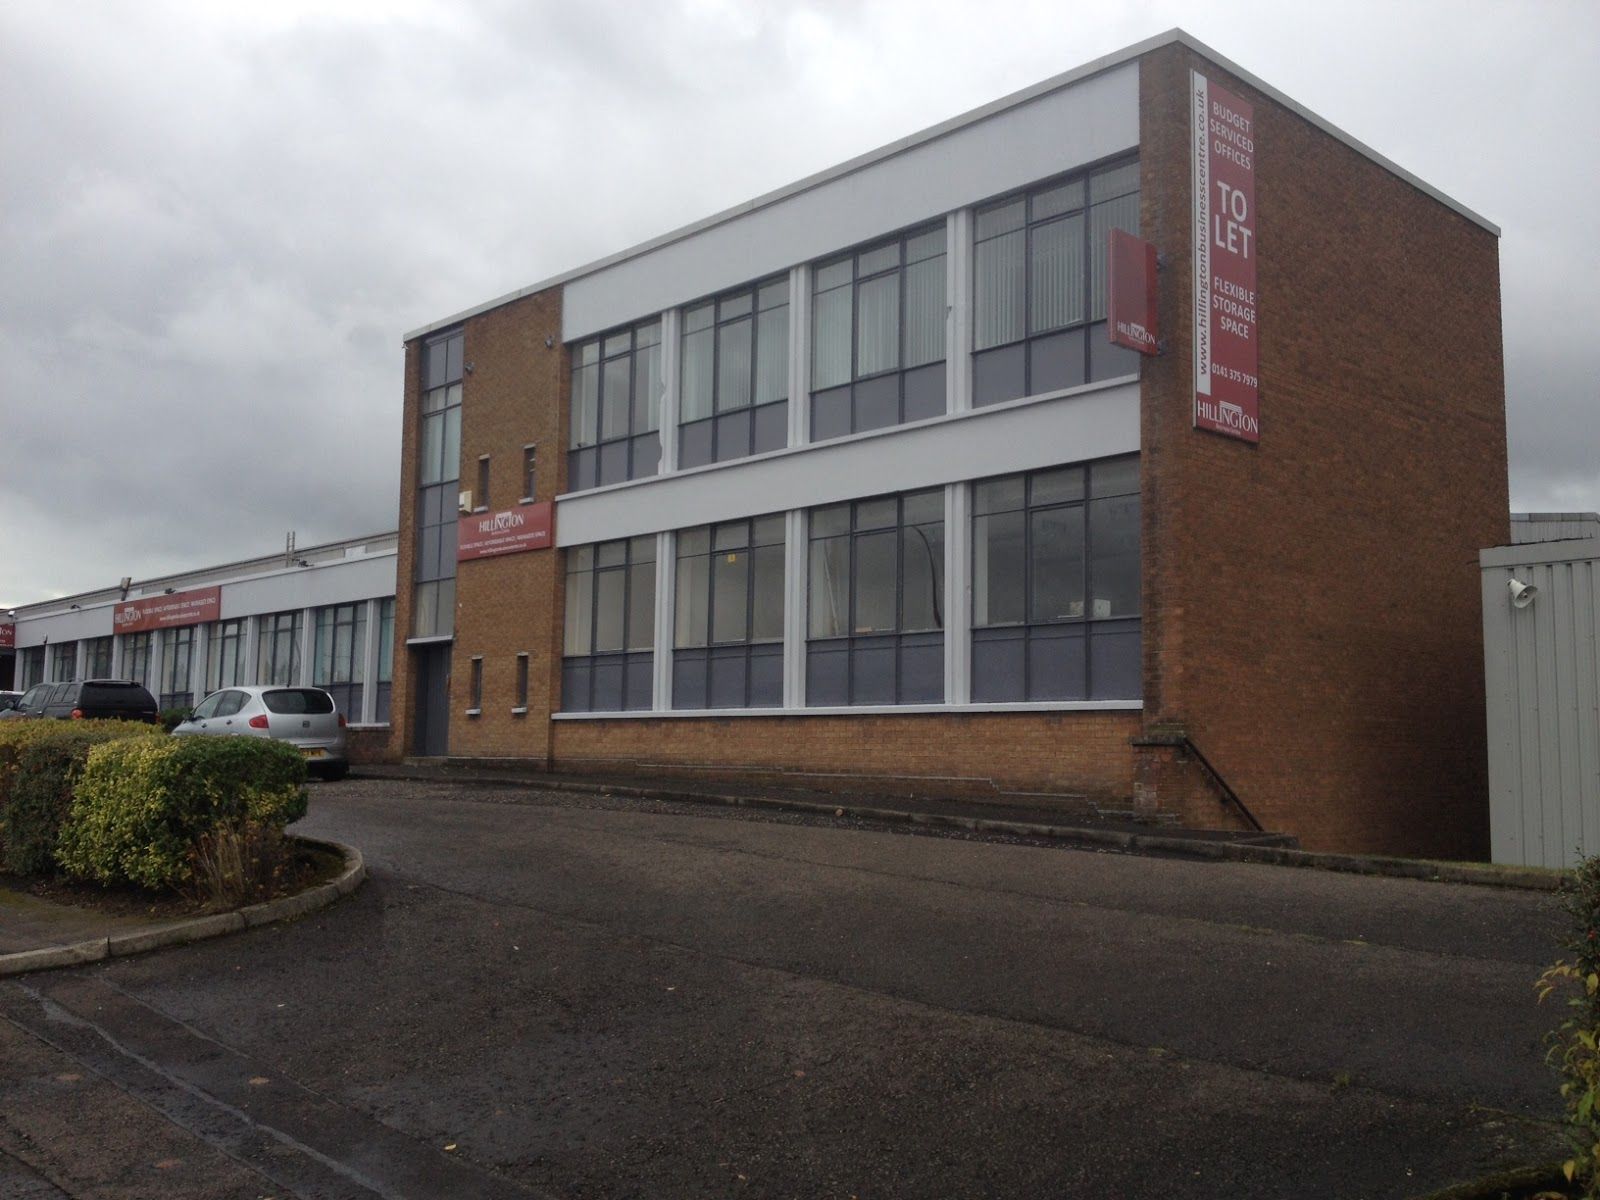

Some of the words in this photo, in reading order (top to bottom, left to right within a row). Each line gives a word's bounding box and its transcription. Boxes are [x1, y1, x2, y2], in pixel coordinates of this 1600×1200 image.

[1213, 101, 1250, 133] BUDGET
[1210, 119, 1254, 153] SERVICED
[1214, 140, 1251, 170] OFFICES
[1217, 180, 1247, 223] TO
[1197, 90, 1208, 375] www.hillingtonbusinesscentre.co.uk
[1215, 214, 1251, 259] LET
[1214, 276, 1254, 305] FLEXIBLE
[1213, 294, 1256, 324] STORAGE
[1117, 321, 1155, 345] HILLINGTON
[1220, 316, 1249, 339] SPACE
[1211, 362, 1228, 377] 0141
[1229, 367, 1241, 382] 375
[1242, 372, 1258, 388] 7979
[1197, 400, 1258, 434] HILLINGTON
[479, 513, 524, 533] HILLINGTON
